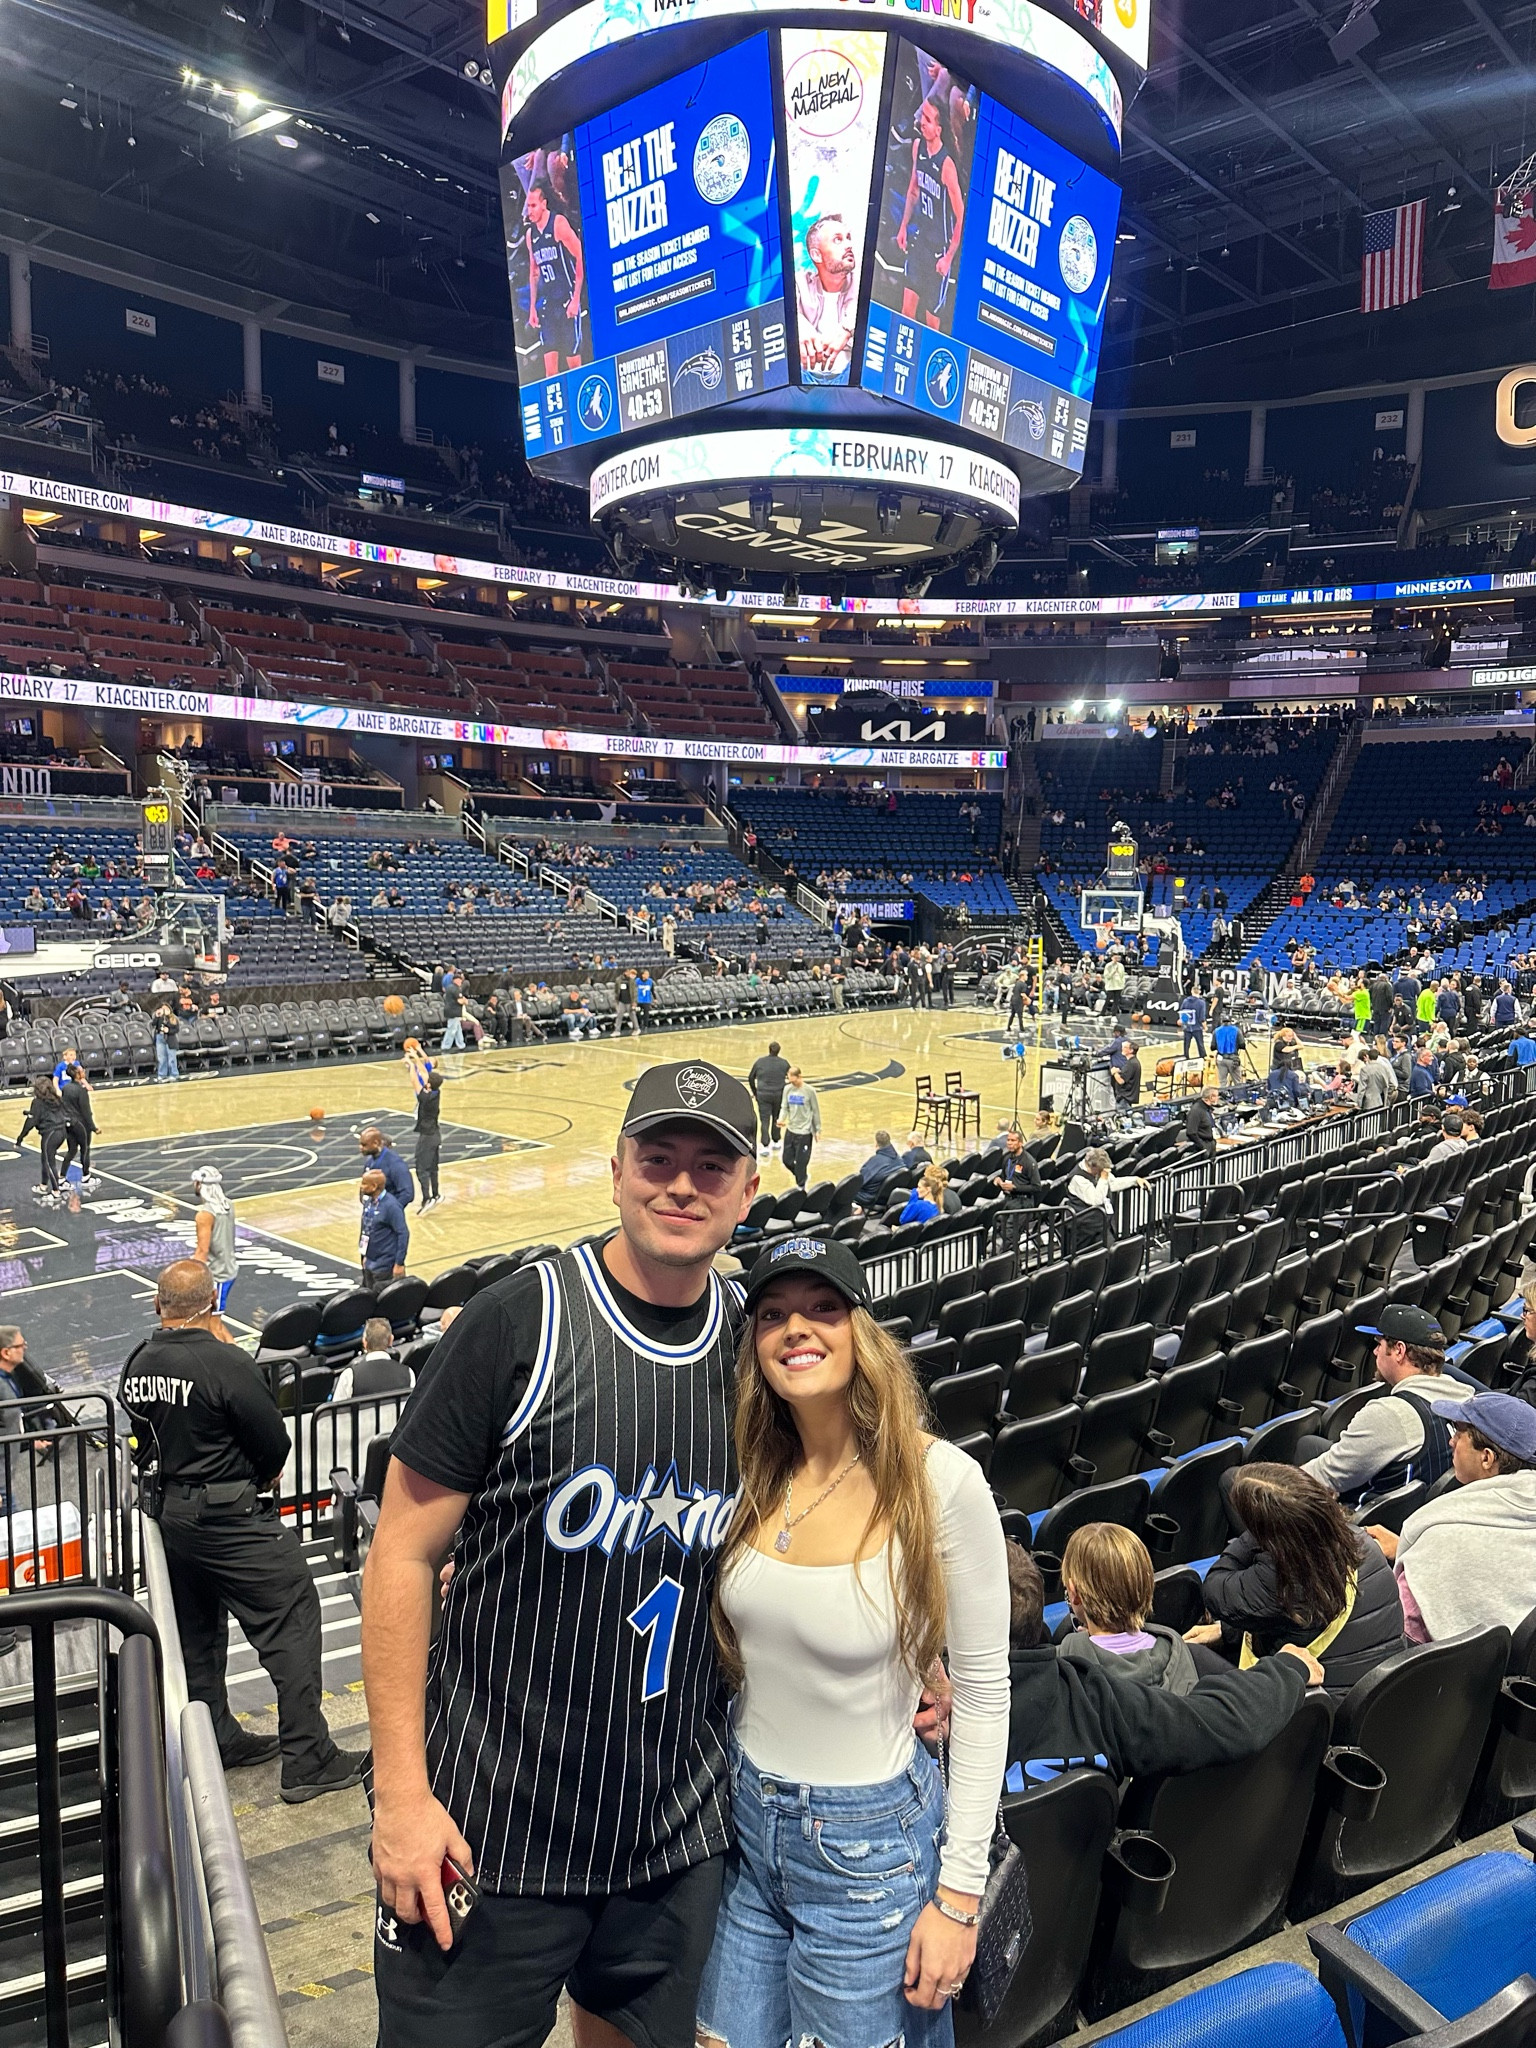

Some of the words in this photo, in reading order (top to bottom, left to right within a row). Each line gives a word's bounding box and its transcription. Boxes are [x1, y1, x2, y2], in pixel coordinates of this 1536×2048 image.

[791, 84, 815, 101] ALL
[817, 68, 849, 90] NEW
[794, 86, 859, 120] MATERIAL
[602, 140, 643, 201] BEAT
[644, 121, 678, 186] THE
[993, 147, 1031, 212] BEAT
[1028, 170, 1057, 228] THE
[606, 179, 668, 250] BUZZER
[921, 191, 934, 220] 50
[987, 196, 1040, 269] BUZZER
[624, 254, 637, 272] THE
[636, 244, 661, 268] SEASON
[660, 236, 682, 258] TICKET
[540, 264, 556, 283] 50
[628, 269, 642, 288] LIST
[641, 265, 655, 283] FOR
[653, 257, 673, 278] EARLY
[672, 247, 698, 271] ACCESS
[131, 314, 151, 328] 226
[731, 320, 743, 334] LAST
[899, 323, 909, 336] LAST
[732, 329, 752, 354] 5-5
[762, 322, 786, 371] ORL
[865, 325, 888, 373] MIN
[895, 333, 914, 359] 5-5
[322, 366, 340, 377] 227
[619, 353, 657, 377] COUNTDOWN
[656, 350, 665, 364] TO
[734, 357, 753, 372] STREAK
[969, 358, 1002, 385] COUNTDOWN
[619, 367, 666, 395] GAMETIME
[735, 368, 754, 392] W2
[895, 374, 906, 396] L1
[967, 372, 1008, 405] GAMETIME
[546, 391, 564, 413] 5-5
[627, 389, 664, 422] 40:53
[968, 397, 1000, 432] 40:53
[523, 402, 542, 442] MIN
[1054, 404, 1070, 427] 5-5
[1380, 413, 1399, 425] 232
[553, 426, 563, 446] L1
[1070, 417, 1088, 453] ORL
[1175, 433, 1193, 444] 231
[831, 442, 928, 476] FEBRUARY
[939, 455, 954, 480] 17
[0, 475, 14, 491] 17
[29, 481, 130, 513] KIACENTER.COM
[260, 525, 286, 543] NATE
[289, 530, 338, 552] BARGATZE
[349, 543, 363, 558] BE
[674, 512, 868, 568] CENTER
[493, 566, 543, 585] FEBRUARY
[546, 574, 557, 587] 17
[565, 576, 639, 596] KIACENTER.COM
[1395, 578, 1473, 597] MINNESOTA
[741, 592, 764, 608] NATE
[955, 600, 1002, 614] FEBRUARY
[1007, 600, 1017, 613] 17
[1025, 599, 1102, 613] KIACENTER.COM
[1211, 595, 1236, 608] NATE
[1257, 594, 1271, 605] NEXT
[1271, 593, 1288, 604] GAME
[1291, 590, 1312, 604] JAN.
[1312, 588, 1324, 602] 10
[1324, 592, 1334, 602] AT
[1334, 587, 1353, 602] BOS
[901, 680, 925, 696] RISE
[1475, 671, 1508, 685] BUD
[63, 681, 78, 701] 17
[96, 688, 209, 714] KIACENTER.COM
[357, 713, 385, 732] NATE
[389, 715, 443, 736] BARGATZE
[454, 722, 470, 740] BE
[861, 719, 945, 742] KIA
[607, 738, 658, 754] FEBRUARY
[664, 742, 674, 755] 17
[684, 745, 764, 761] KIACENTER.COM
[881, 752, 904, 764] NATE
[909, 752, 959, 765] BARGATZE
[971, 752, 986, 766] BE
[270, 783, 333, 808] MAGIC
[884, 903, 904, 918] RISE
[94, 953, 163, 968] GEICO
[1146, 1000, 1179, 1011] KIA
[680, 1078, 711, 1095] Liberty
[770, 1238, 827, 1262] MAGIC
[124, 1376, 194, 1407] SECURITY
[626, 1574, 684, 1703] 1
